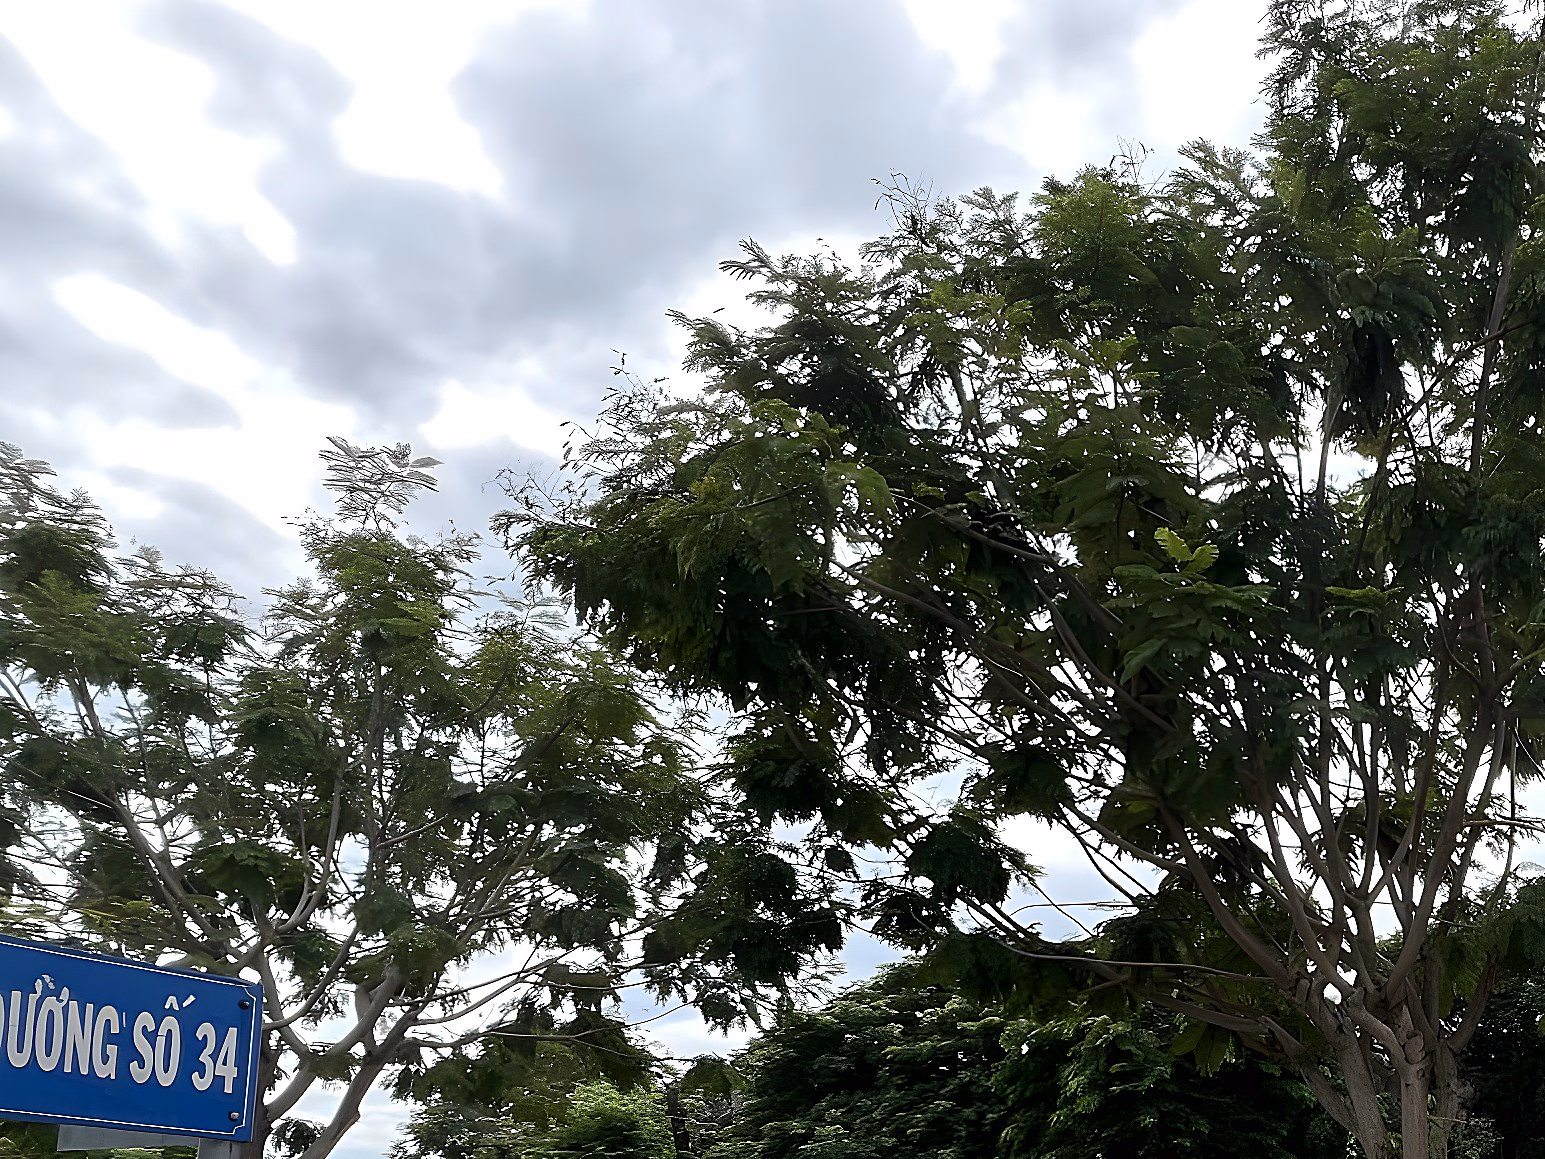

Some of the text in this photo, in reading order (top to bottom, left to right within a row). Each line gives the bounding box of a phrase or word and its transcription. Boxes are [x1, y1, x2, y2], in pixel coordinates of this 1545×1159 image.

[0, 974, 238, 1094] ƯỜNG SỐ 34
